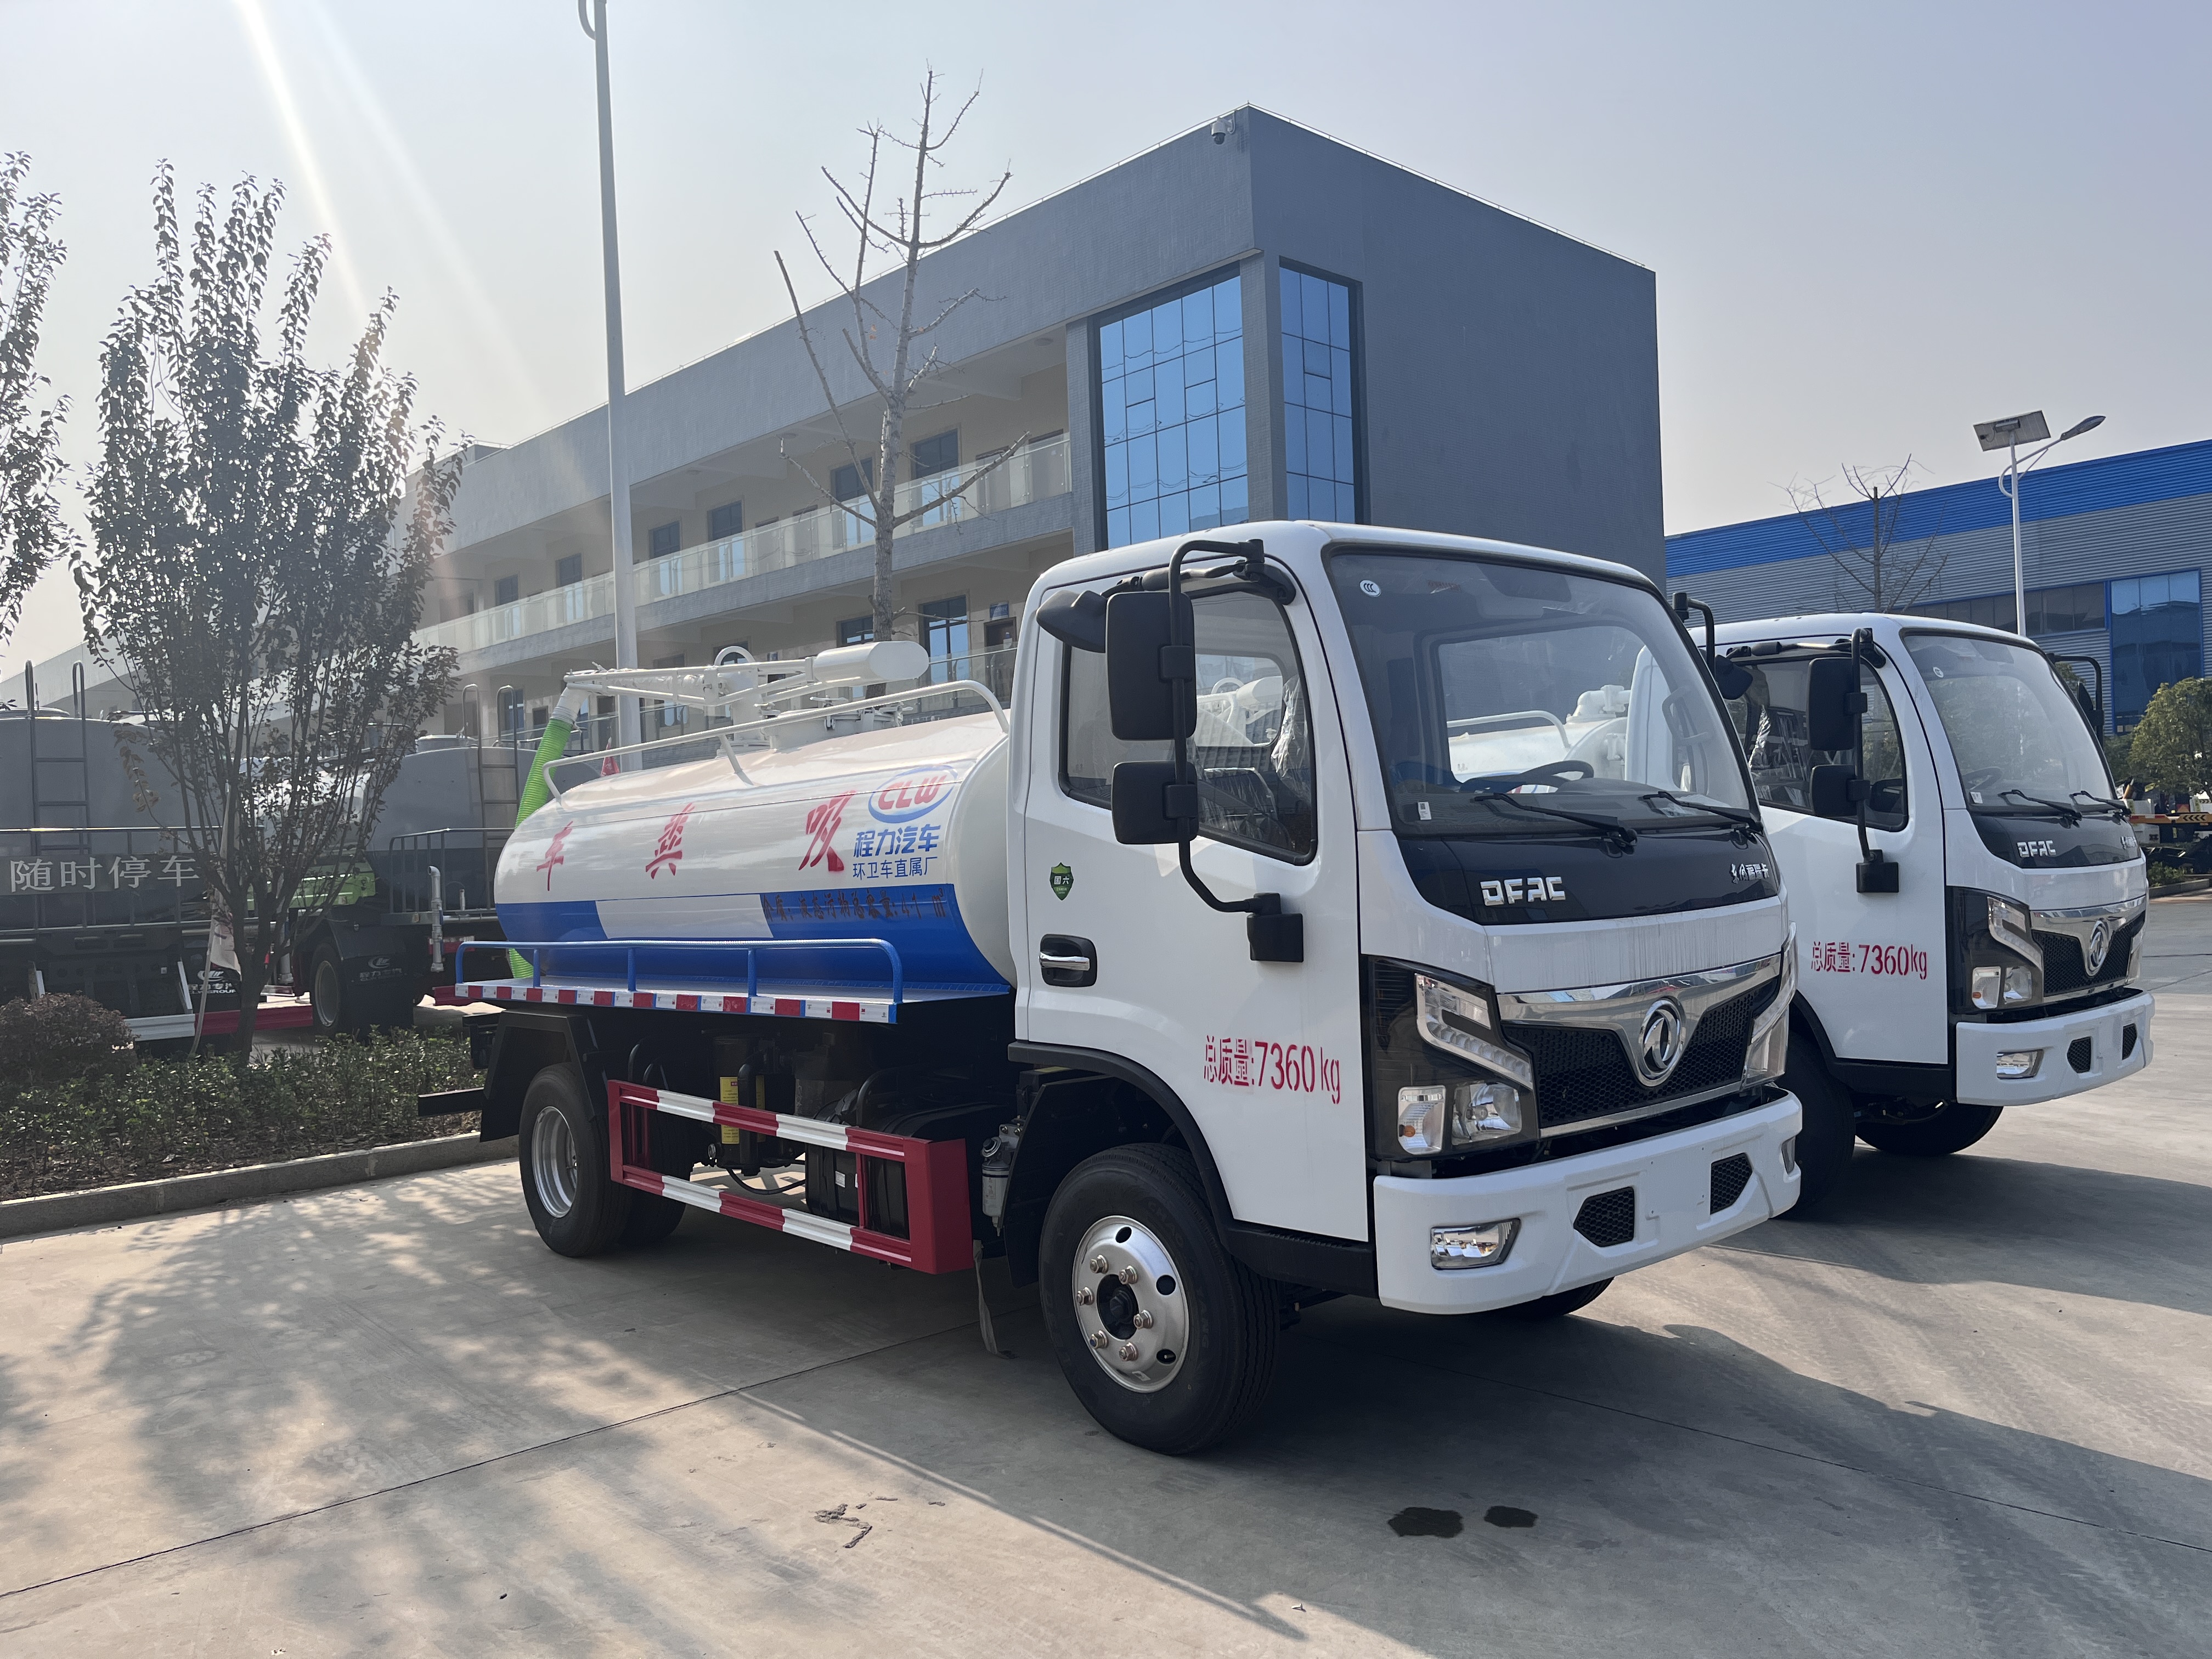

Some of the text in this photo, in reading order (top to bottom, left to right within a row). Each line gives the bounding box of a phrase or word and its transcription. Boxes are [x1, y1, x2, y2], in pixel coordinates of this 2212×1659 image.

[878, 775, 947, 810] CLW
[853, 824, 941, 857] 程力汽车
[2017, 840, 2057, 857] DFAC
[10, 855, 200, 893] 随时停车
[853, 856, 938, 881] 环卫车直属厂
[1480, 876, 1566, 906] DFAC
